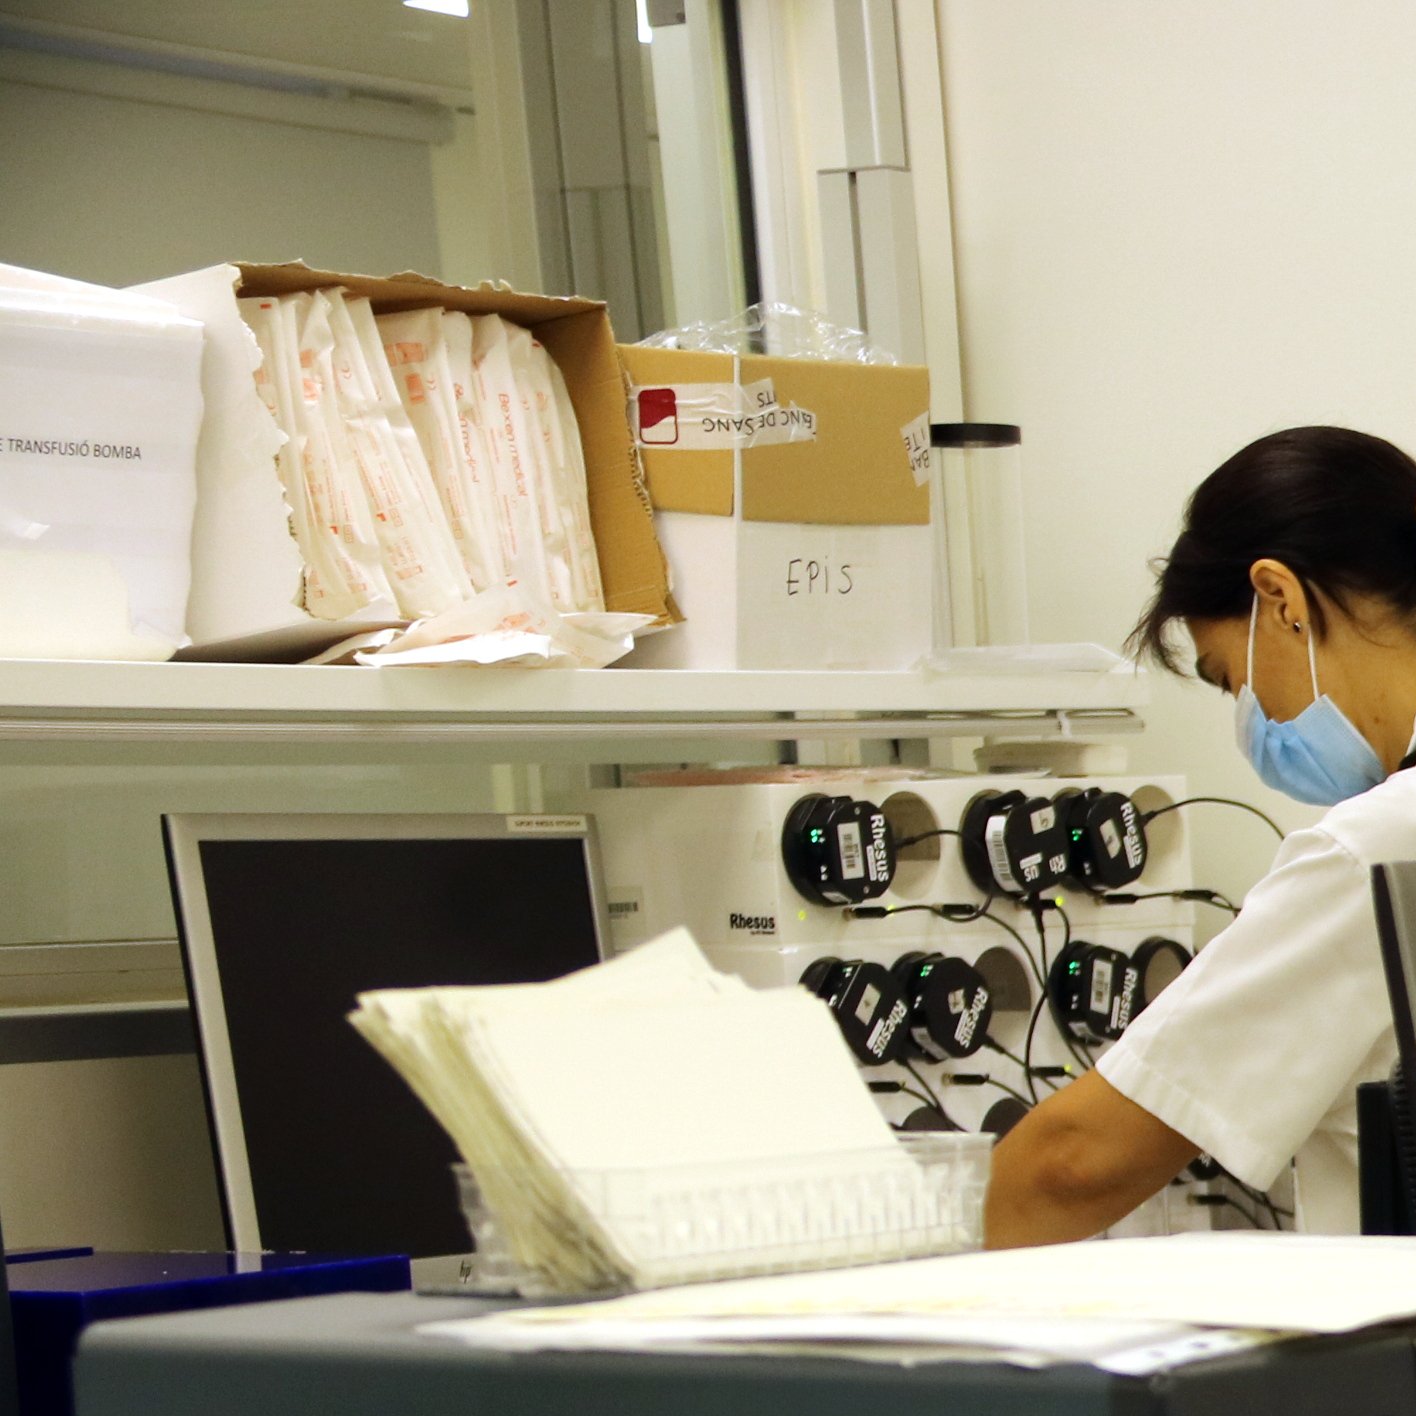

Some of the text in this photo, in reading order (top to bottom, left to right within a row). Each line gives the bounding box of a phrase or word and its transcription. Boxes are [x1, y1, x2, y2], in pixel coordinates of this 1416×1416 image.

[8, 438, 142, 460] TRANSFUSIÓ BOMBA
[702, 417, 754, 436] SANG
[869, 813, 890, 884] Rhesus
[1119, 801, 1143, 867] Rhesus
[729, 912, 776, 930] Rhesus
[871, 998, 908, 1059] Rhesus
[958, 985, 989, 1049] Rhesus
[1117, 967, 1138, 1030] Rhesus
